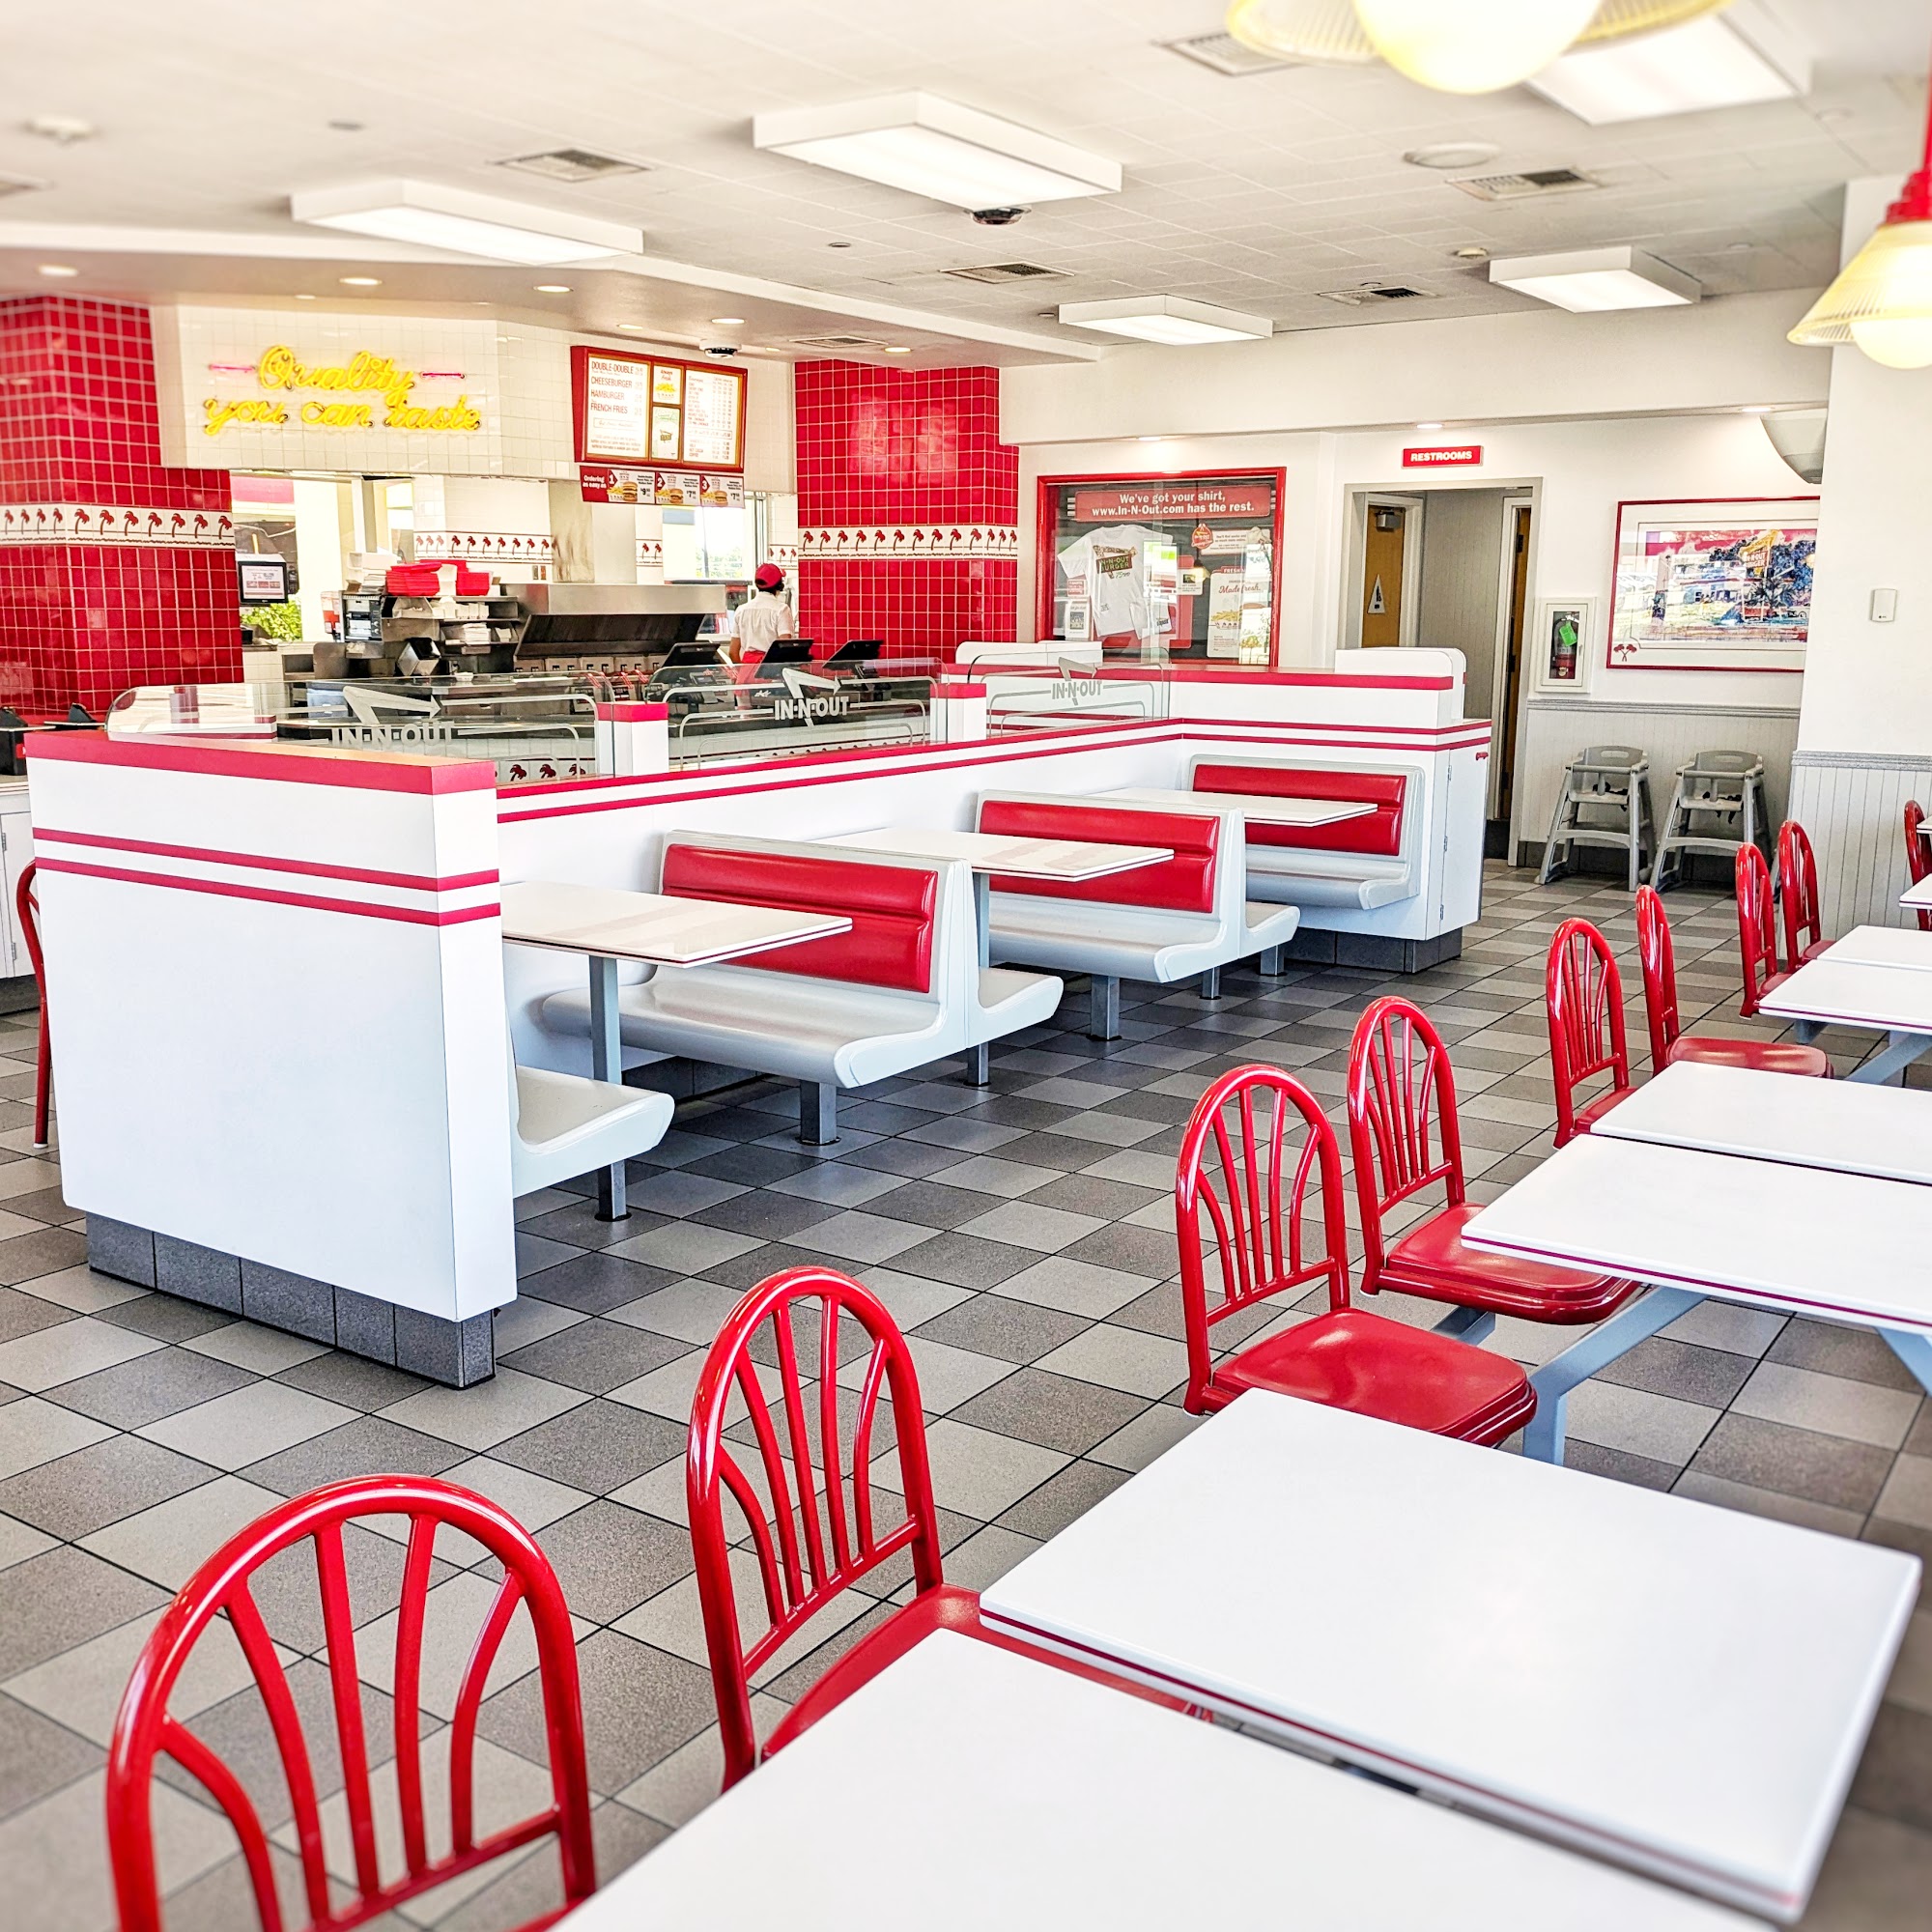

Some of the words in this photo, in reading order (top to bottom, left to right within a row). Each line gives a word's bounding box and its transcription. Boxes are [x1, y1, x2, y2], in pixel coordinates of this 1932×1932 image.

[591, 360, 634, 375] DOUBLE-DOUBLE
[258, 345, 415, 406] Quality
[590, 376, 633, 388] CHEESEBURGER
[590, 388, 625, 401] HAMBURGER
[590, 402, 611, 412] FRENCH
[612, 405, 628, 414] FRIES
[203, 397, 289, 435] you
[300, 401, 373, 426] can
[384, 394, 481, 430] taste
[1410, 450, 1472, 462] RESTROOMS
[583, 474, 605, 483] Ordering
[609, 474, 614, 484] 1
[658, 477, 663, 488] 2
[702, 480, 708, 491] 3
[1119, 493, 1150, 503] We've
[1151, 492, 1169, 504] got
[1172, 492, 1195, 503] your
[1198, 490, 1226, 502] shirt,
[1092, 503, 1184, 516] www.In-N-Out.com
[1187, 502, 1207, 513] has
[1208, 501, 1226, 513] the
[1229, 501, 1255, 512] rest.
[1099, 555, 1129, 566] N-N-OUT
[1218, 583, 1240, 594] Made
